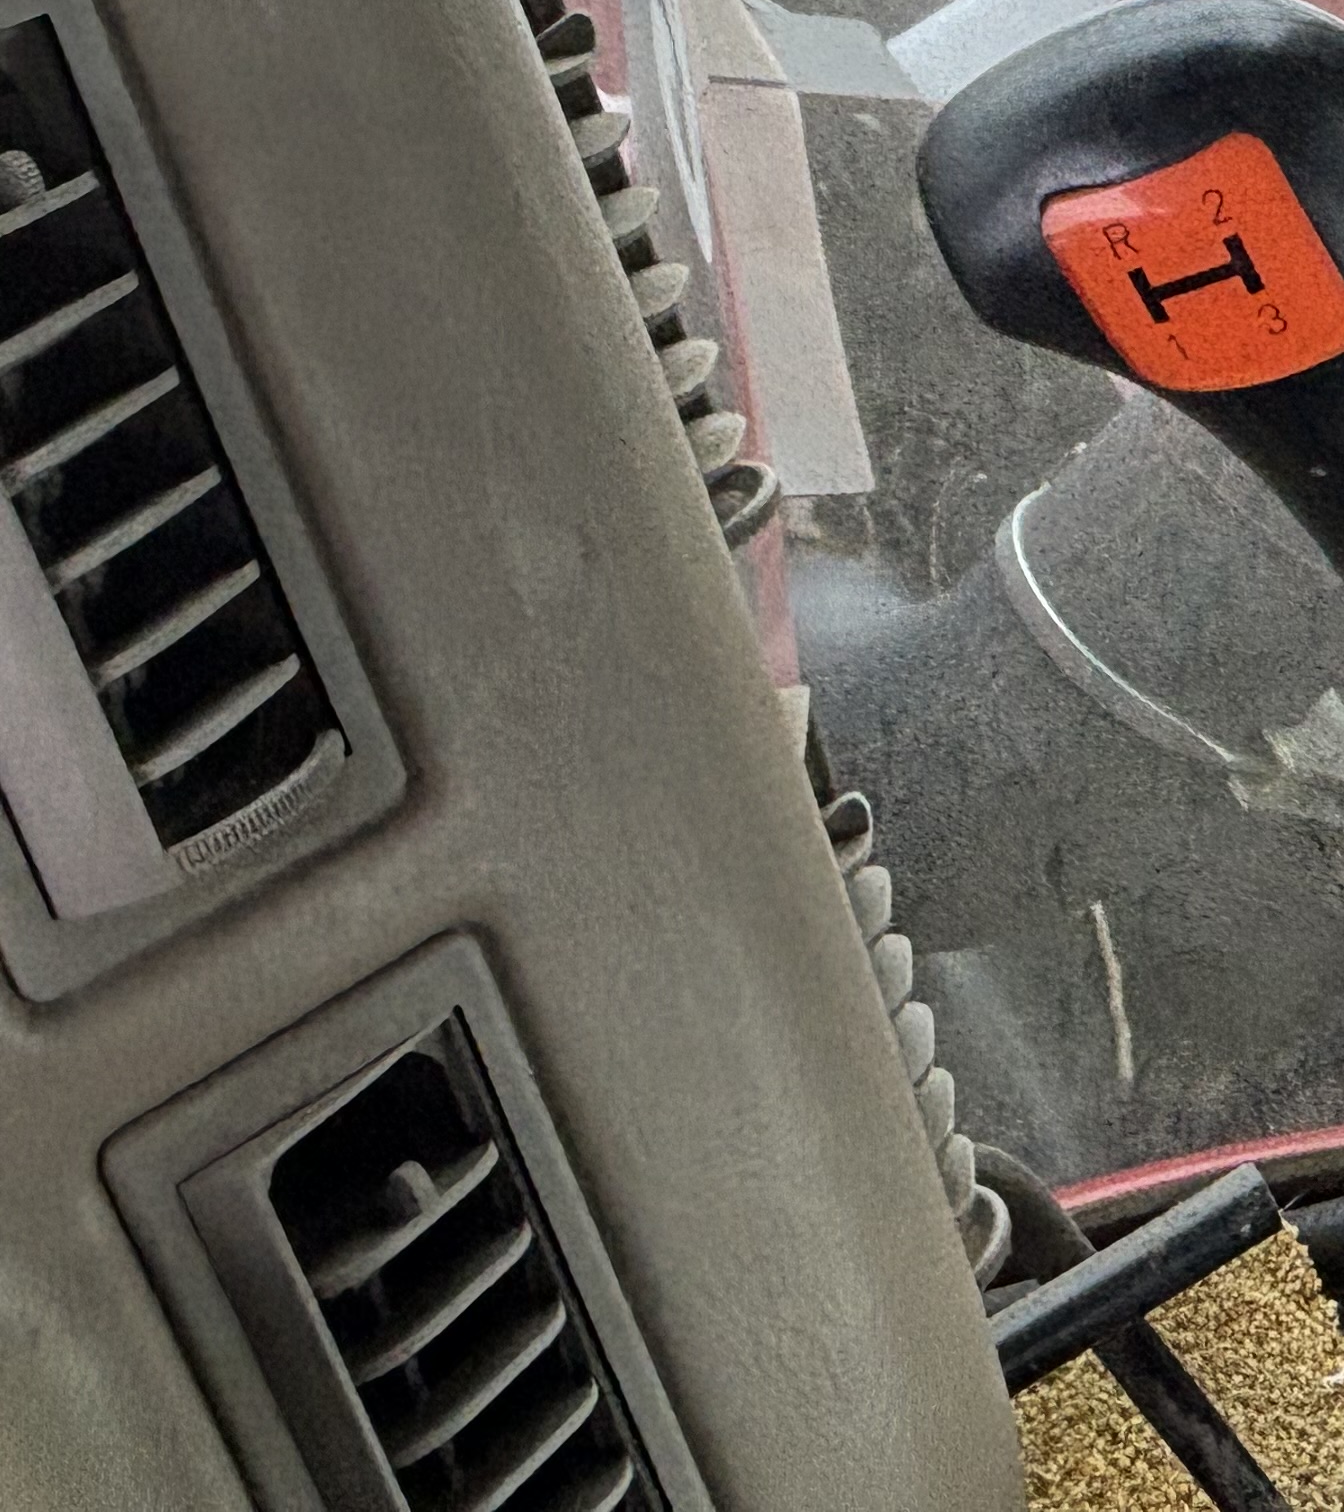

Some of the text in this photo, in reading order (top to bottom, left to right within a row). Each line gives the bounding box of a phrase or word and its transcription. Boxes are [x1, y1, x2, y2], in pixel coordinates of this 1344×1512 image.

[1202, 189, 1233, 226] 2
[1102, 222, 1139, 260] R
[1257, 303, 1288, 336] 3
